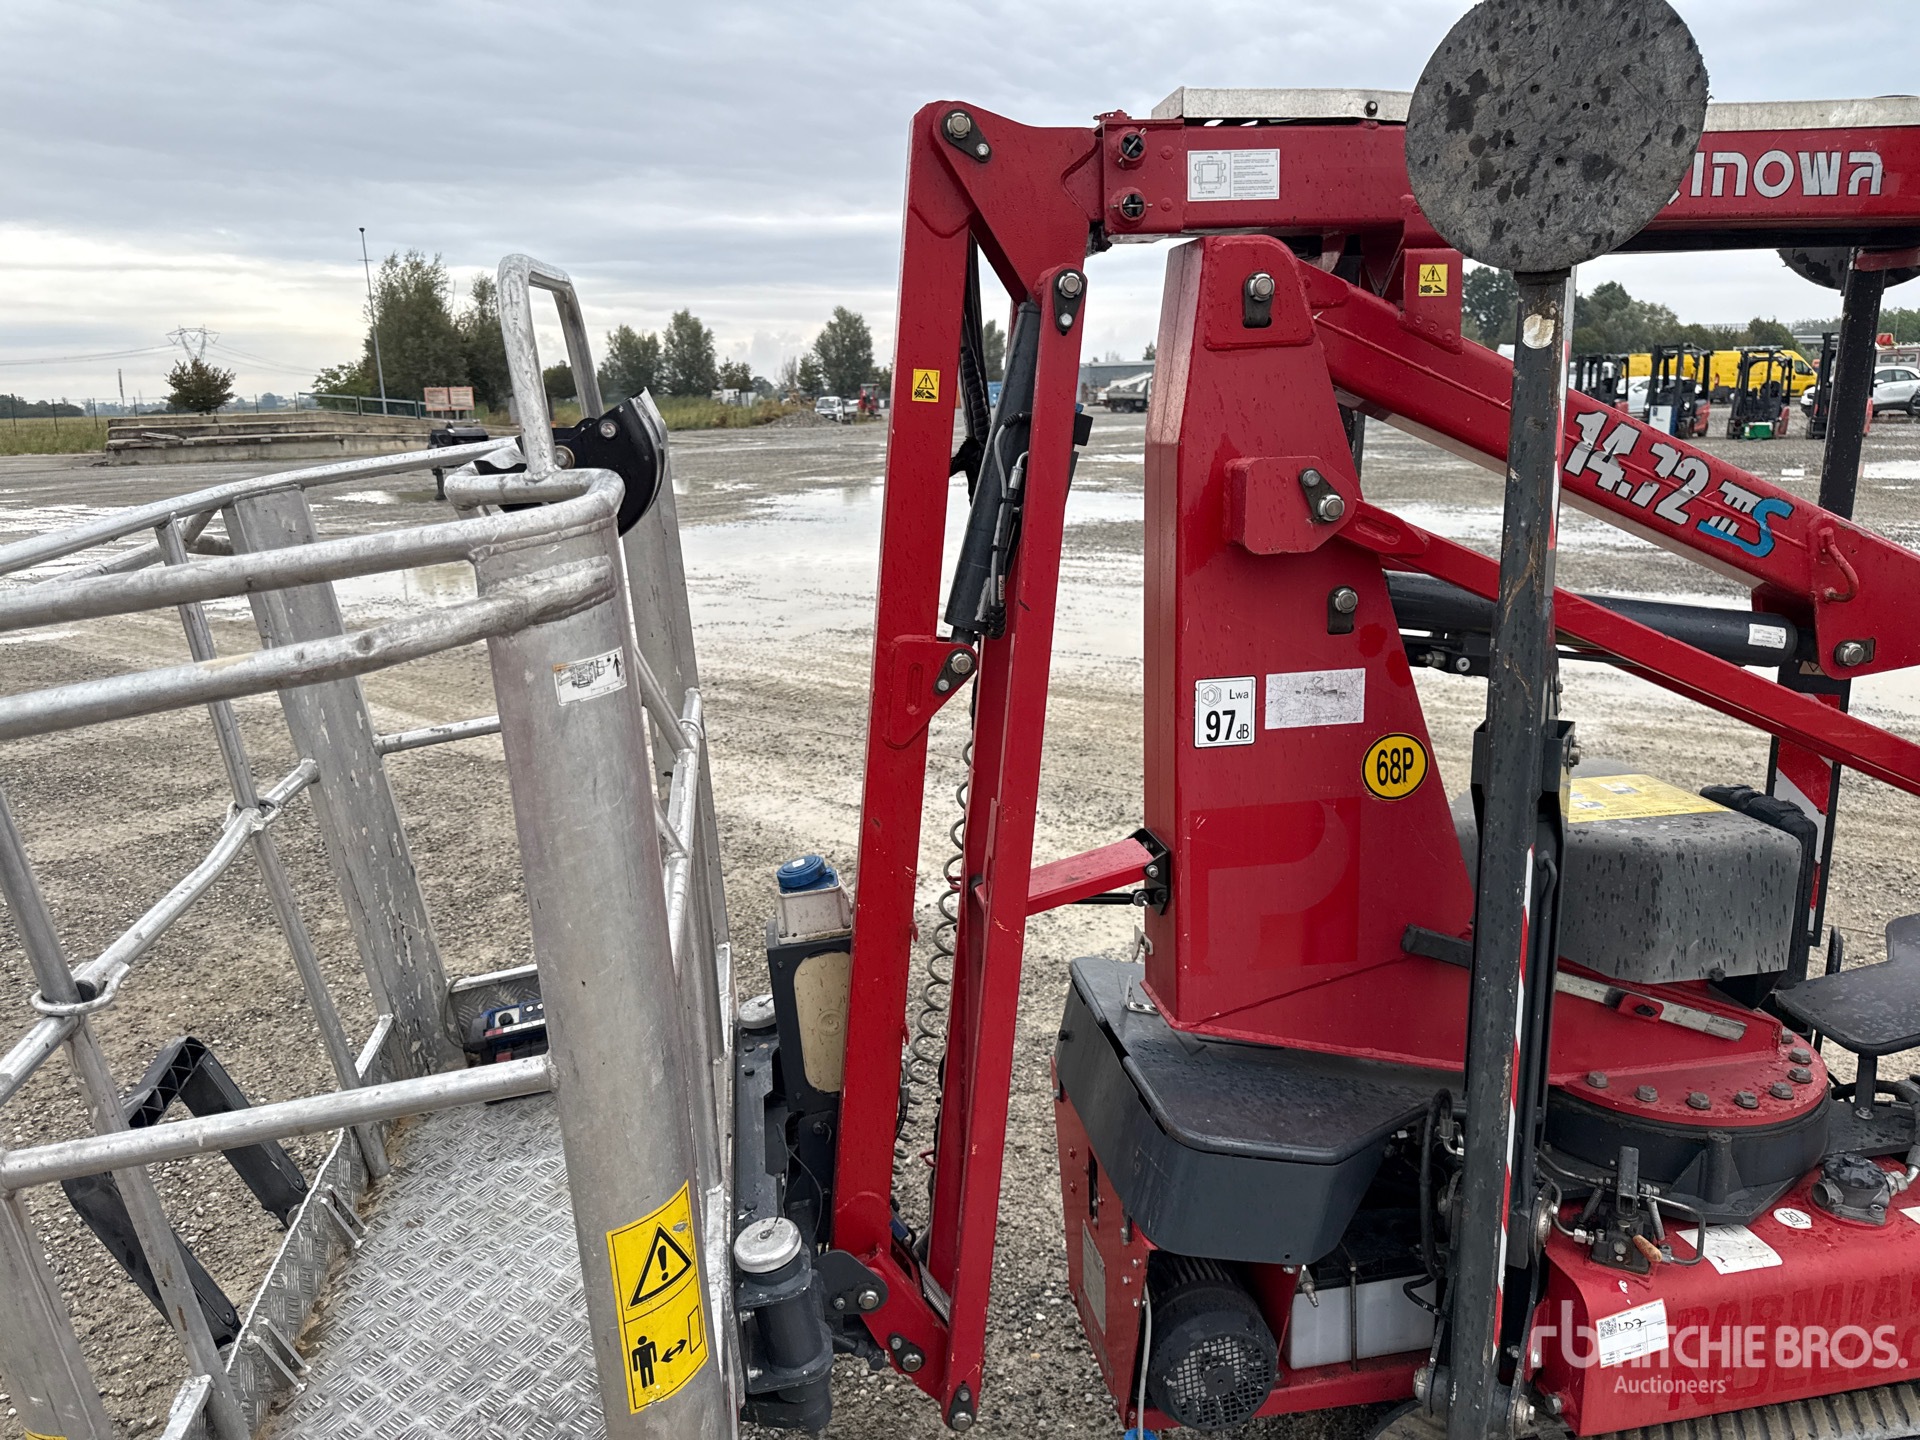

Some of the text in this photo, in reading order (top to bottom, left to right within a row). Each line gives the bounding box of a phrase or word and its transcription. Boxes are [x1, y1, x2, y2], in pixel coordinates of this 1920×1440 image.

[1668, 149, 1883, 205] INOWA
[1564, 411, 1710, 525] 14.72
[1229, 689, 1249, 701] Lwa
[1377, 747, 1414, 786] 68P
